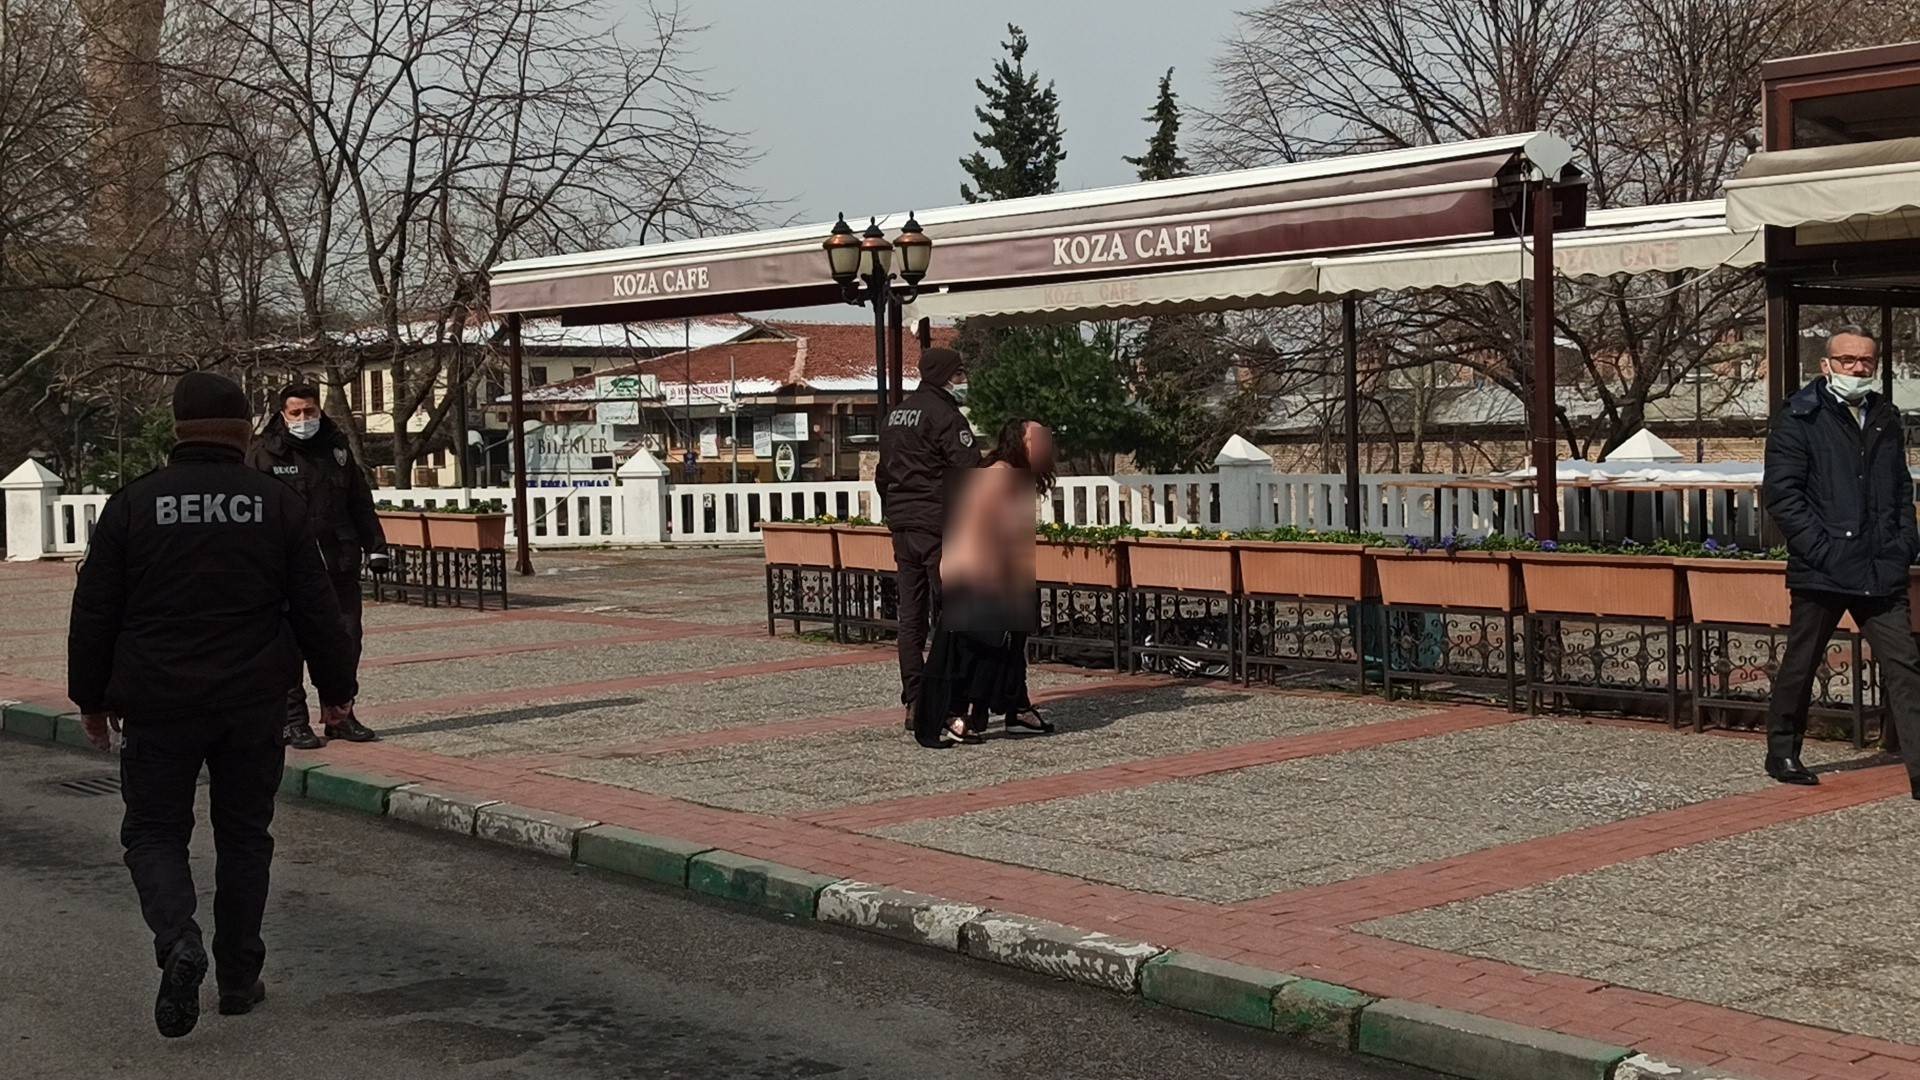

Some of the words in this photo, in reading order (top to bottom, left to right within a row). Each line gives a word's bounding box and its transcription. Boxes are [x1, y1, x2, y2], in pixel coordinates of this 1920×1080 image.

[1053, 232, 1128, 265] KOZA
[1135, 224, 1212, 258] CAFE
[613, 272, 659, 297] KOZA
[663, 266, 709, 292] CAFE
[1043, 286, 1084, 305] KOZA
[1099, 281, 1138, 301] CAFE
